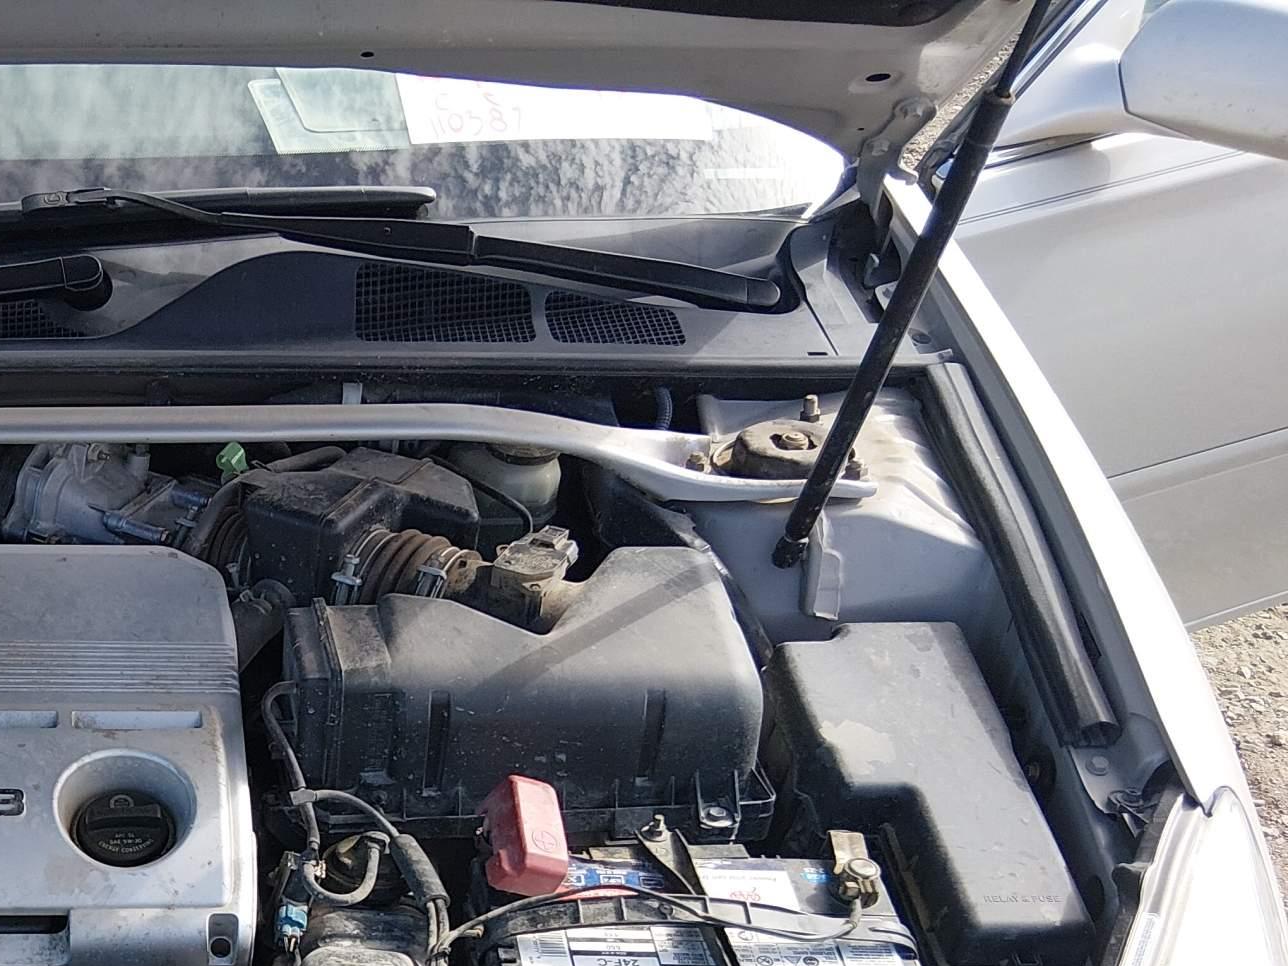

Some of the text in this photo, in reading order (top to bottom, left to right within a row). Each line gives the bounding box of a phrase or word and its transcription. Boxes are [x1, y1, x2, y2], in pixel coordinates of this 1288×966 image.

[983, 895, 1018, 903] RELAY
[1031, 895, 1064, 903] FUSE
[596, 957, 639, 966] 24F-C
